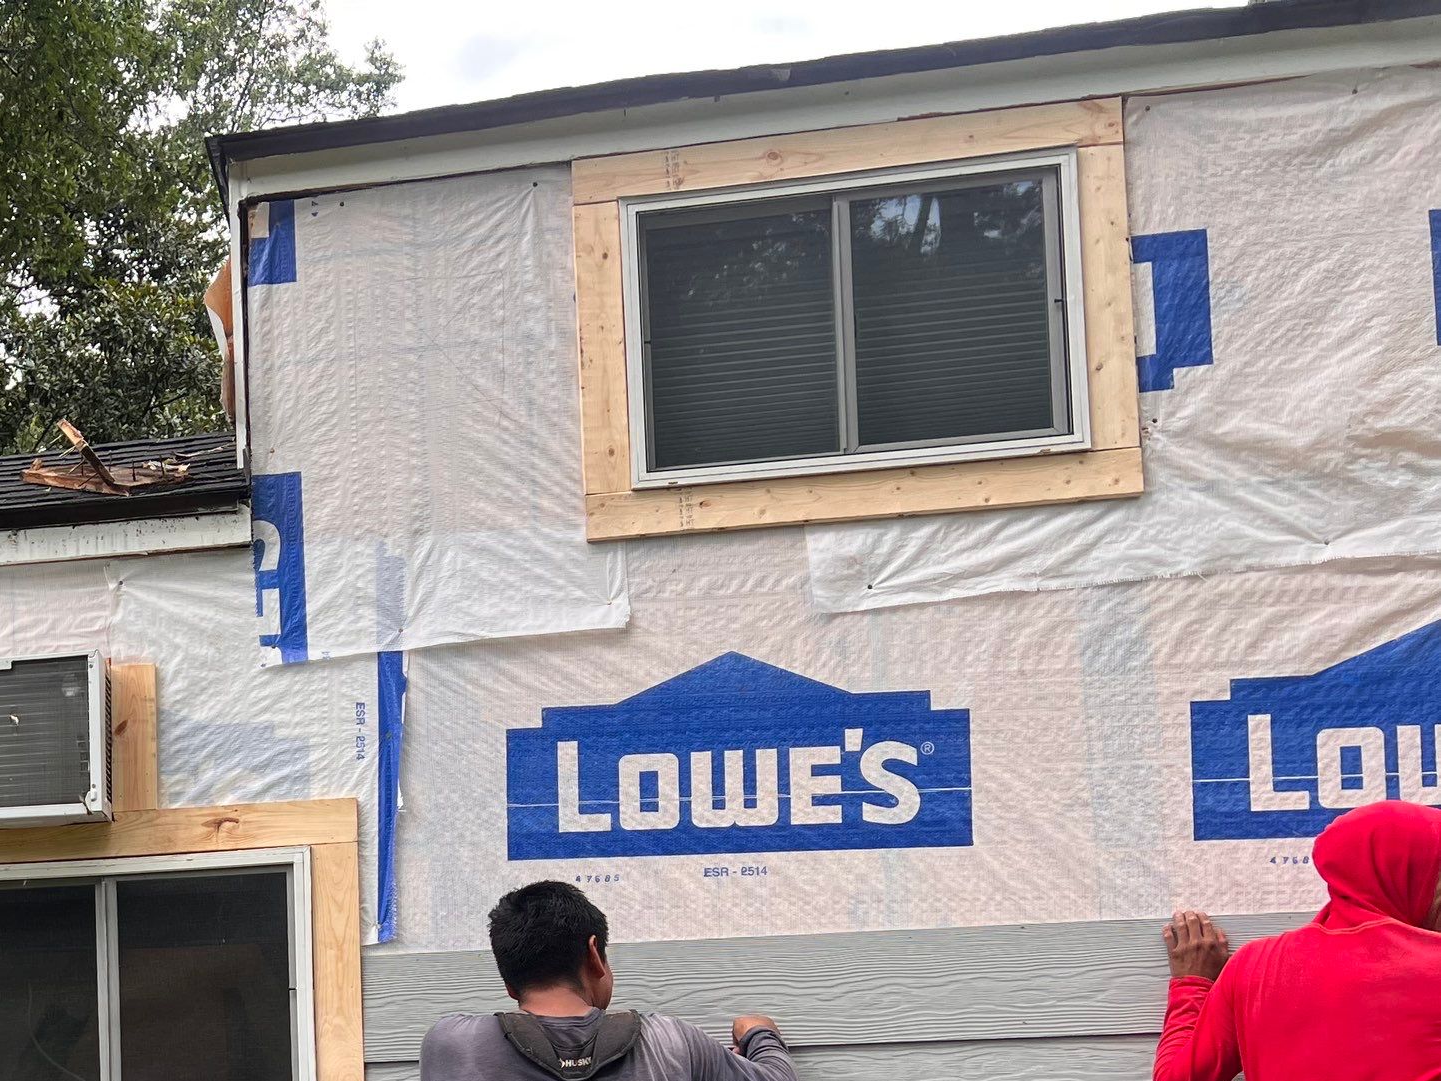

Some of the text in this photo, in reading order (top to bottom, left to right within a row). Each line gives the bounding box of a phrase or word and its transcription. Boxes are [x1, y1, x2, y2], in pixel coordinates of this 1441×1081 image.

[355, 702, 366, 725] ESR
[556, 728, 921, 833] LOWE'S
[703, 867, 729, 877] ESR
[741, 866, 768, 876] 2514
[565, 1056, 591, 1067] HUSKY
